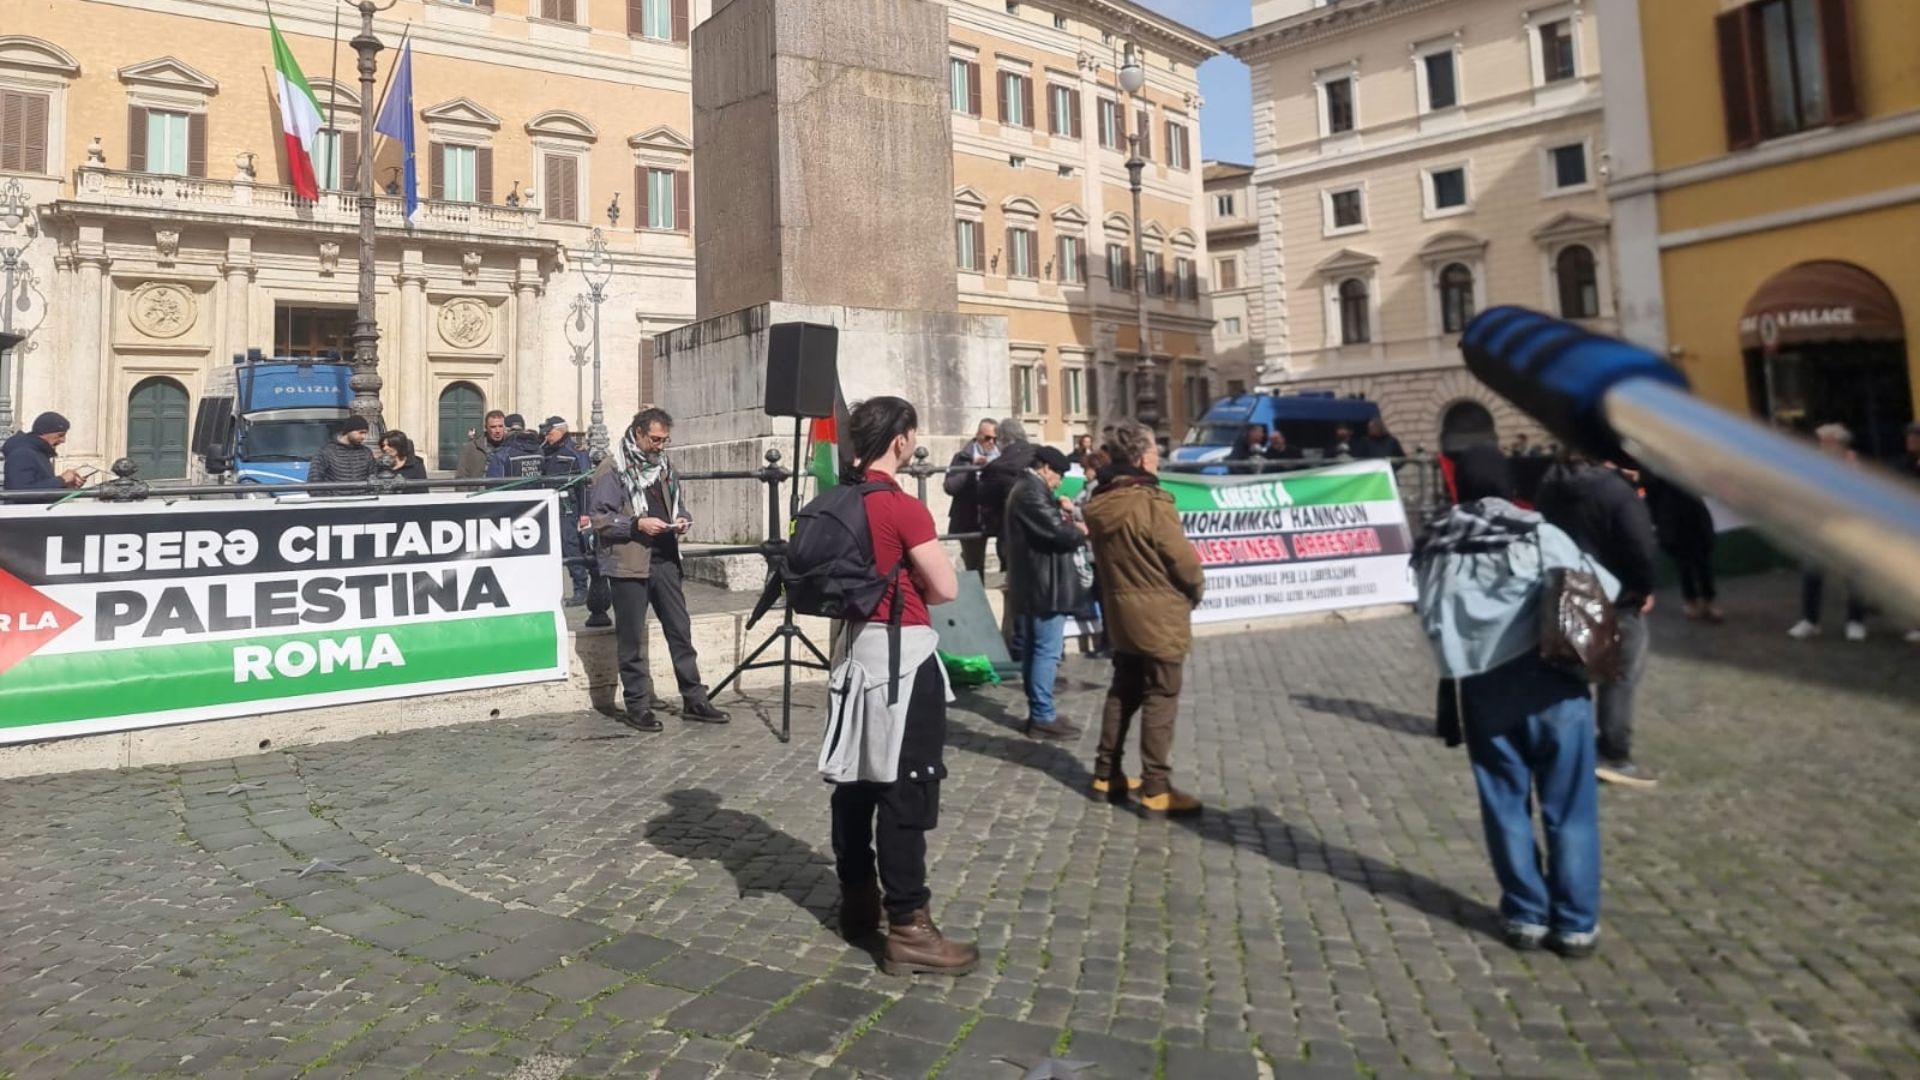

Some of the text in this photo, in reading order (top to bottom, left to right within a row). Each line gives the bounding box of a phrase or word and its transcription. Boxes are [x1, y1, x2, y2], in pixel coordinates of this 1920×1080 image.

[1789, 305, 1854, 326] PALACE
[273, 385, 340, 396] POLIZIA
[1182, 503, 1368, 534] MOHAMMAD HANNOUN
[1292, 528, 1383, 556] ARRESTATI
[95, 565, 510, 642] PALESTINA
[19, 610, 59, 631] LA
[233, 633, 406, 683] ROMA
